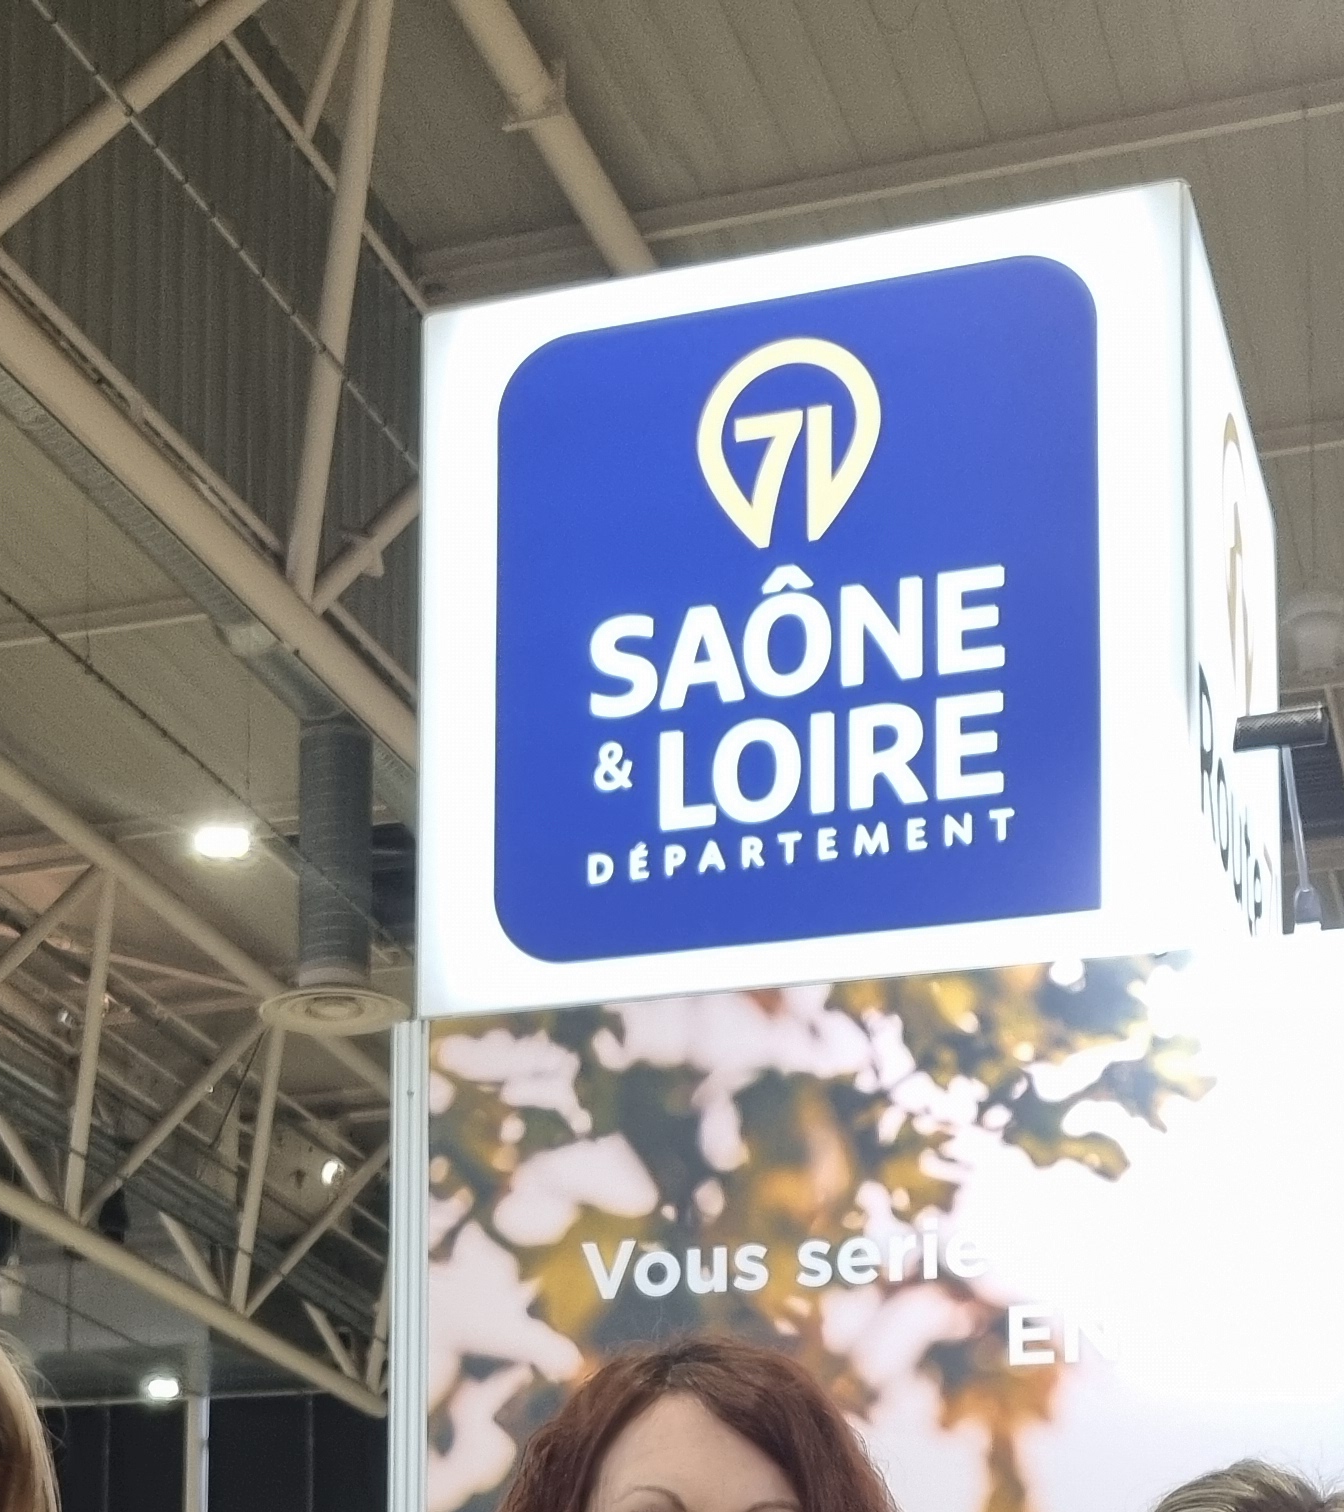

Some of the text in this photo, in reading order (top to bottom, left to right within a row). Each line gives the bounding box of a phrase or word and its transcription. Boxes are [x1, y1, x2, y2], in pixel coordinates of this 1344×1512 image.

[590, 564, 1005, 718] SAÔNE
[593, 691, 1005, 832] & LOIRE
[1199, 661, 1262, 937] Route
[587, 808, 1015, 886] DÉPARTEMENT
[582, 1238, 769, 1300] Vous
[796, 1216, 991, 1288] serie
